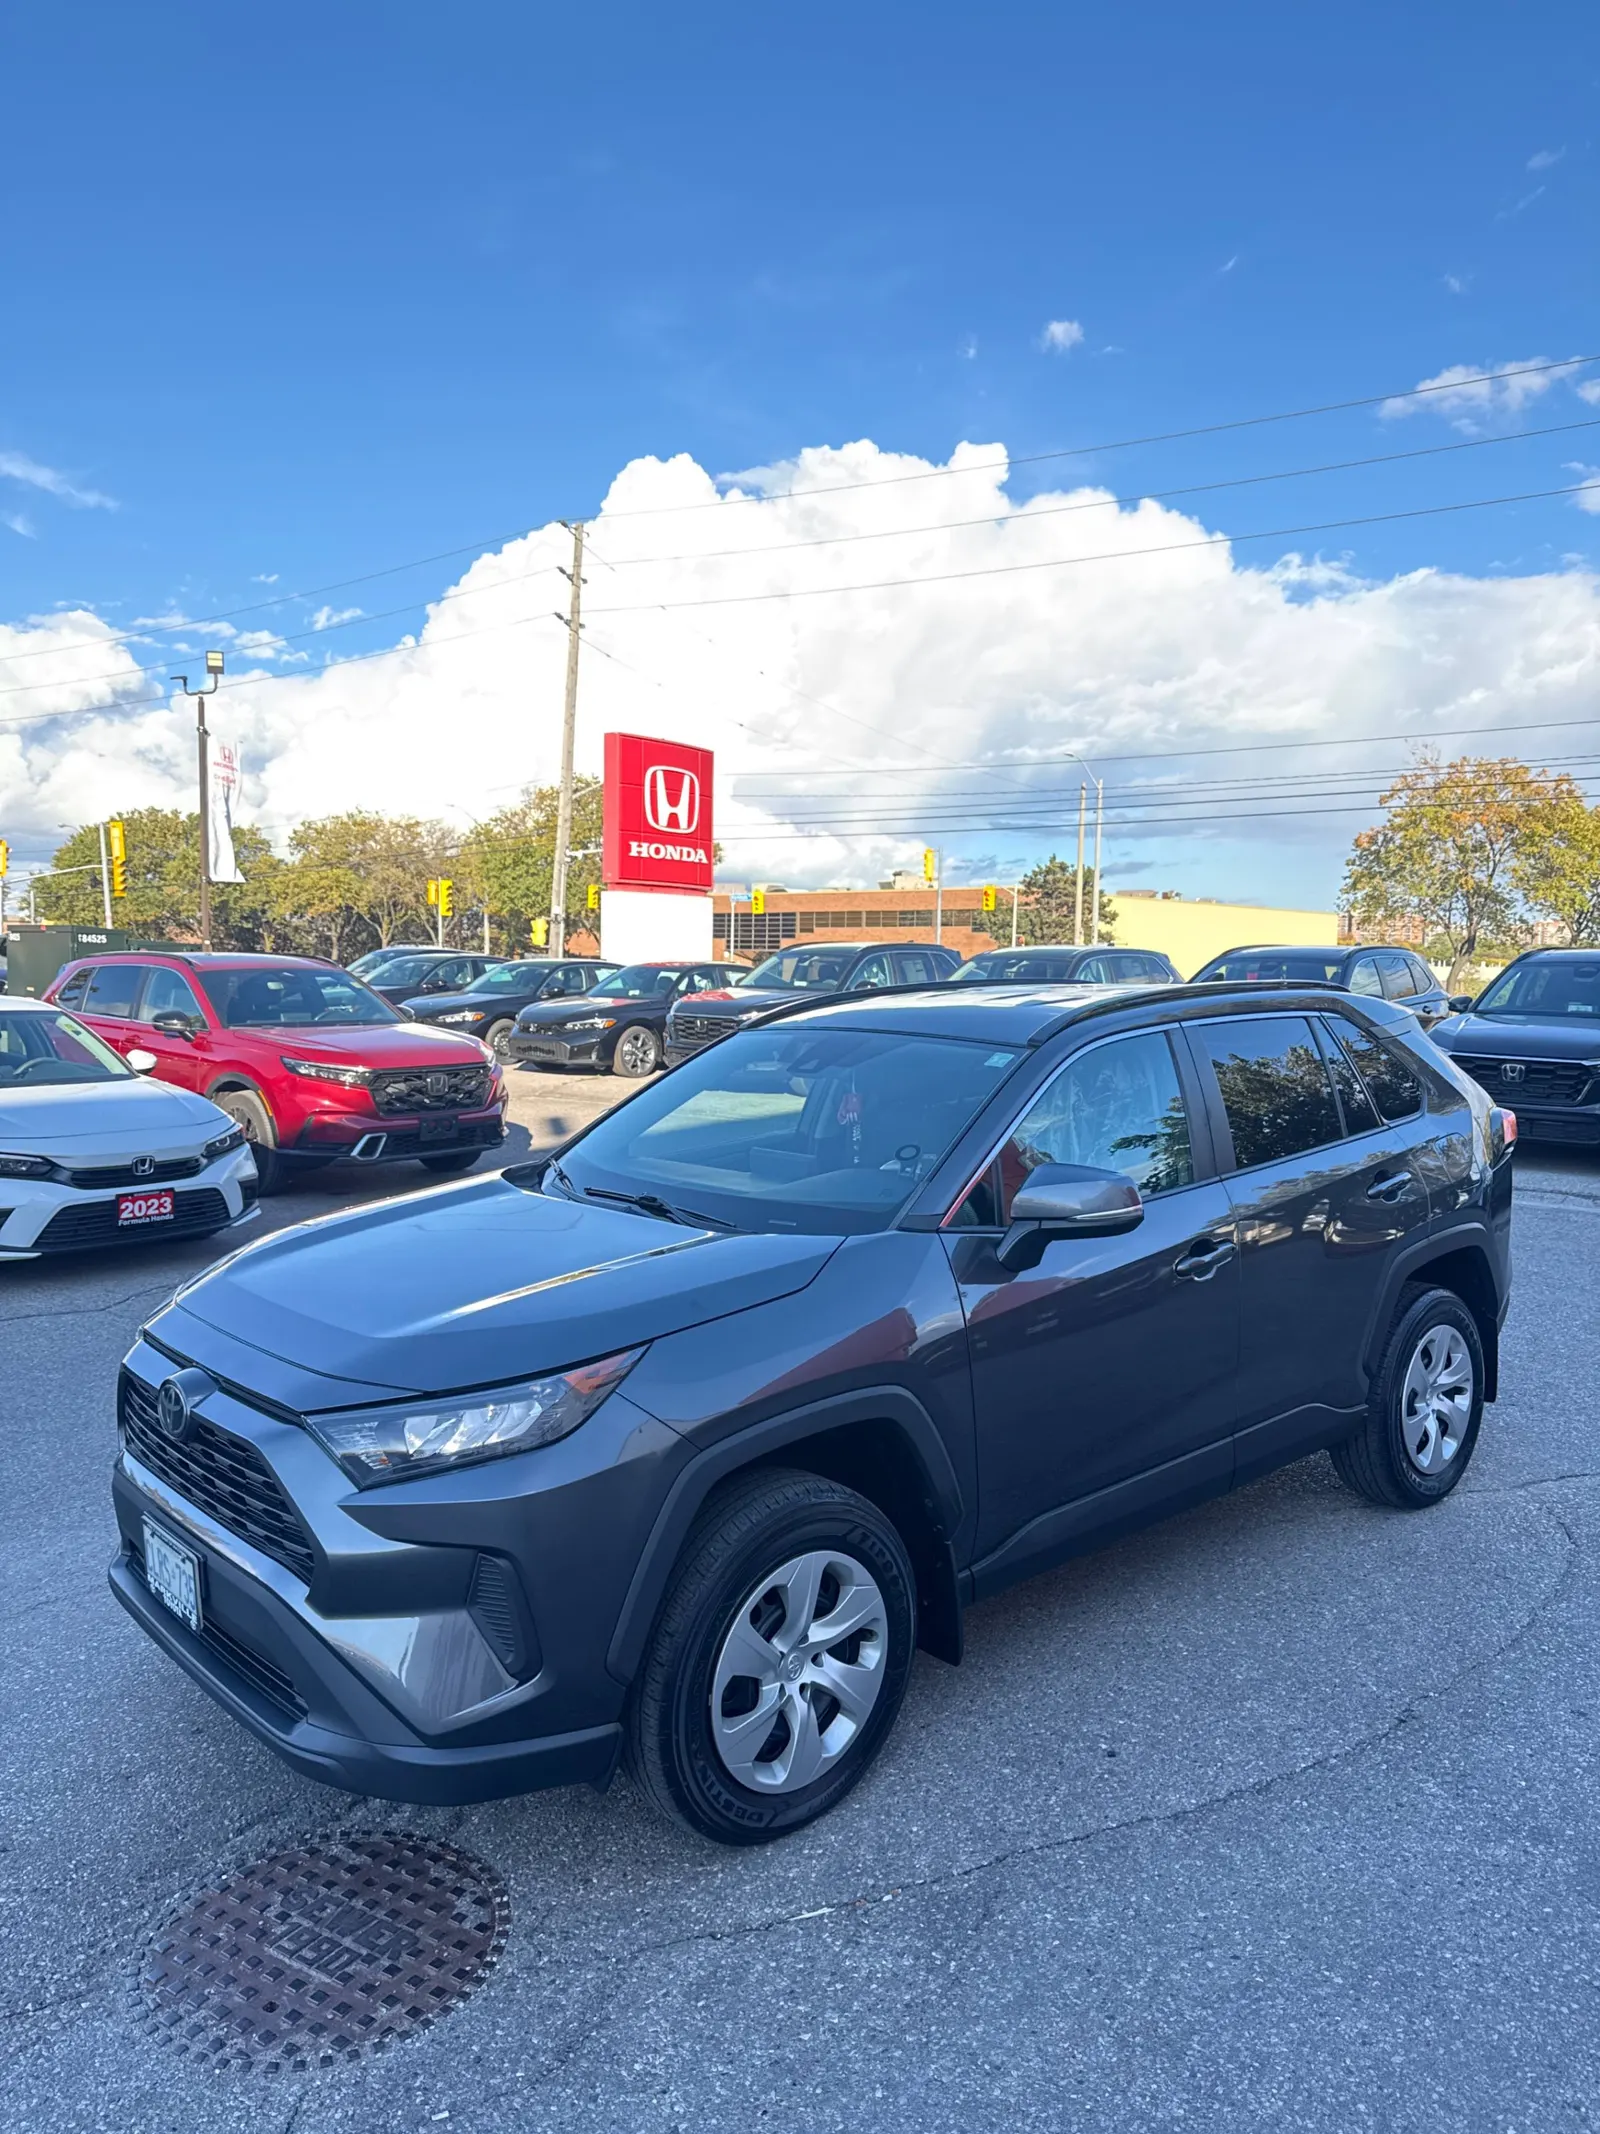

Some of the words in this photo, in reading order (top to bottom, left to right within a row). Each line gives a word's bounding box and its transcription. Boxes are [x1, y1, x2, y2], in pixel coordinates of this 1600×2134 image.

[628, 841, 709, 864] HONDA
[120, 1197, 172, 1218] 2023
[280, 1887, 420, 1961] SEWER
